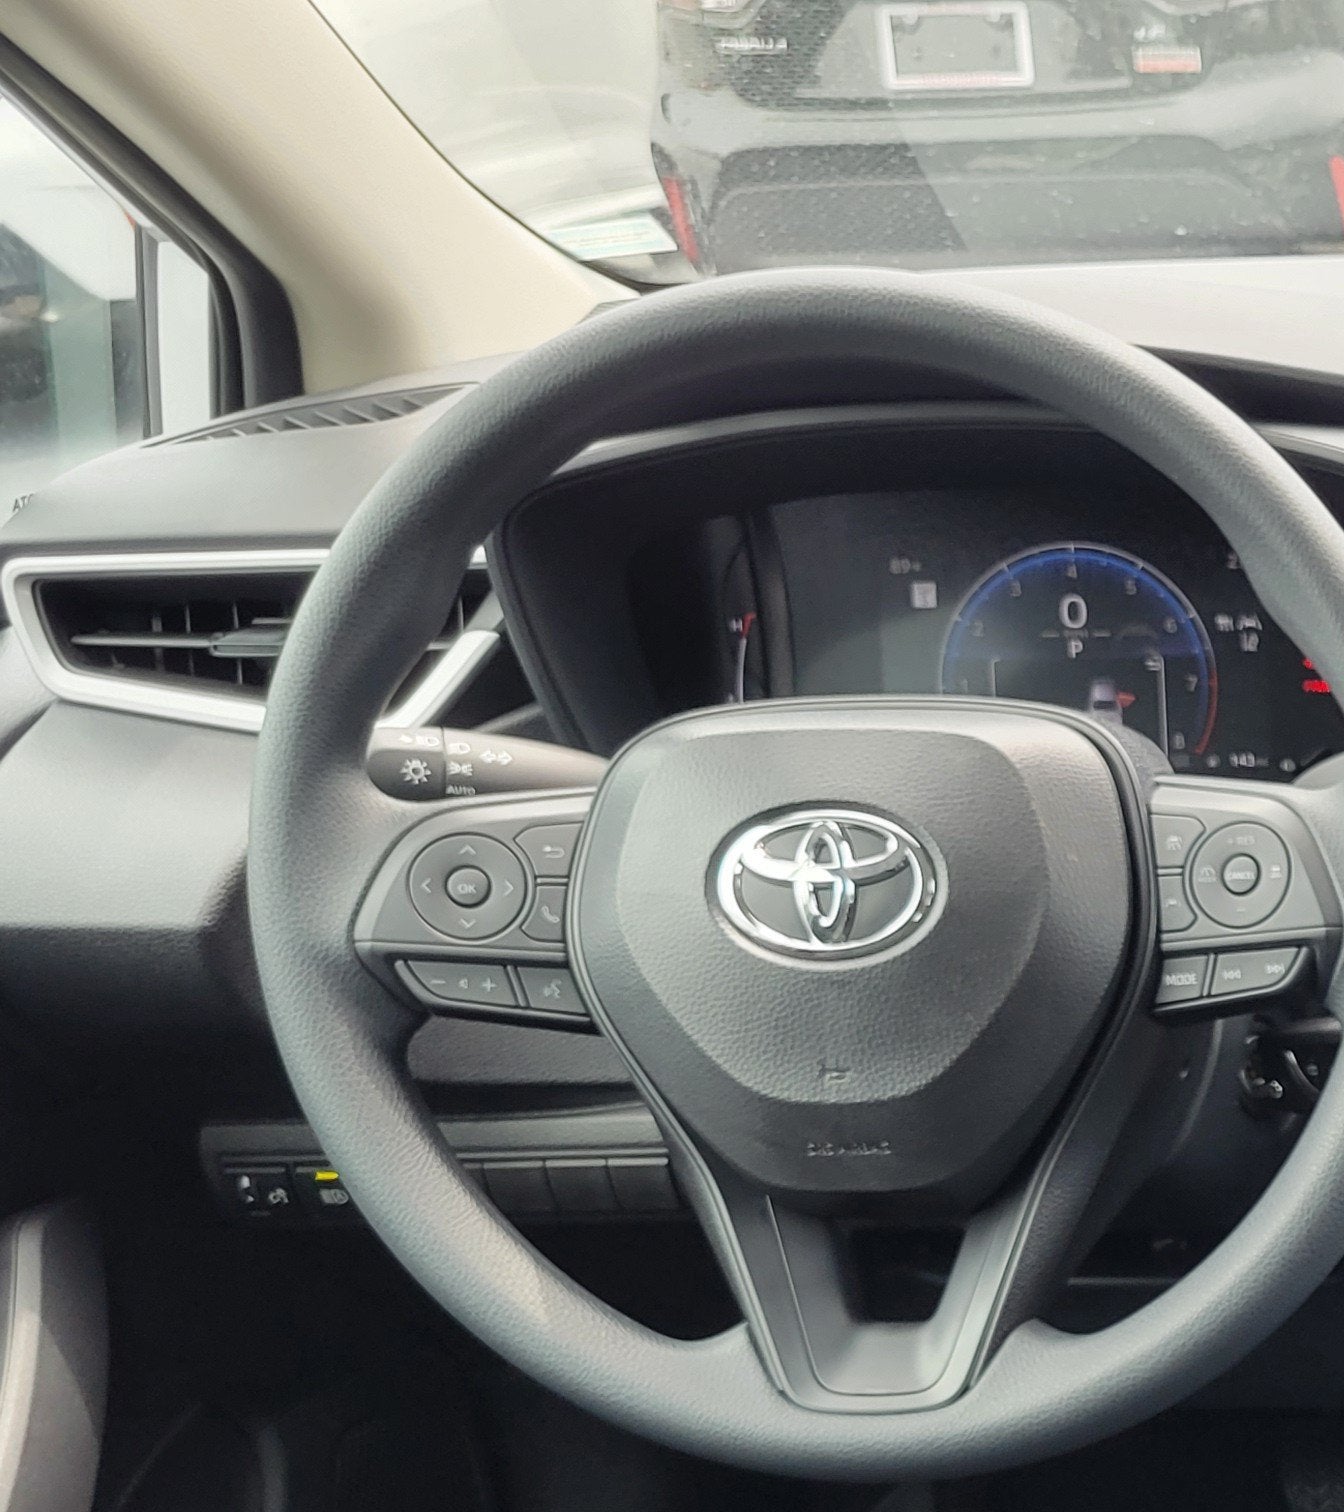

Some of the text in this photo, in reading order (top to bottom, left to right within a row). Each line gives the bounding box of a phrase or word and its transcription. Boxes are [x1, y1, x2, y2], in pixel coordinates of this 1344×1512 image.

[446, 785, 476, 796] AUTO
[456, 883, 477, 895] OK
[1165, 973, 1198, 986] MODE
